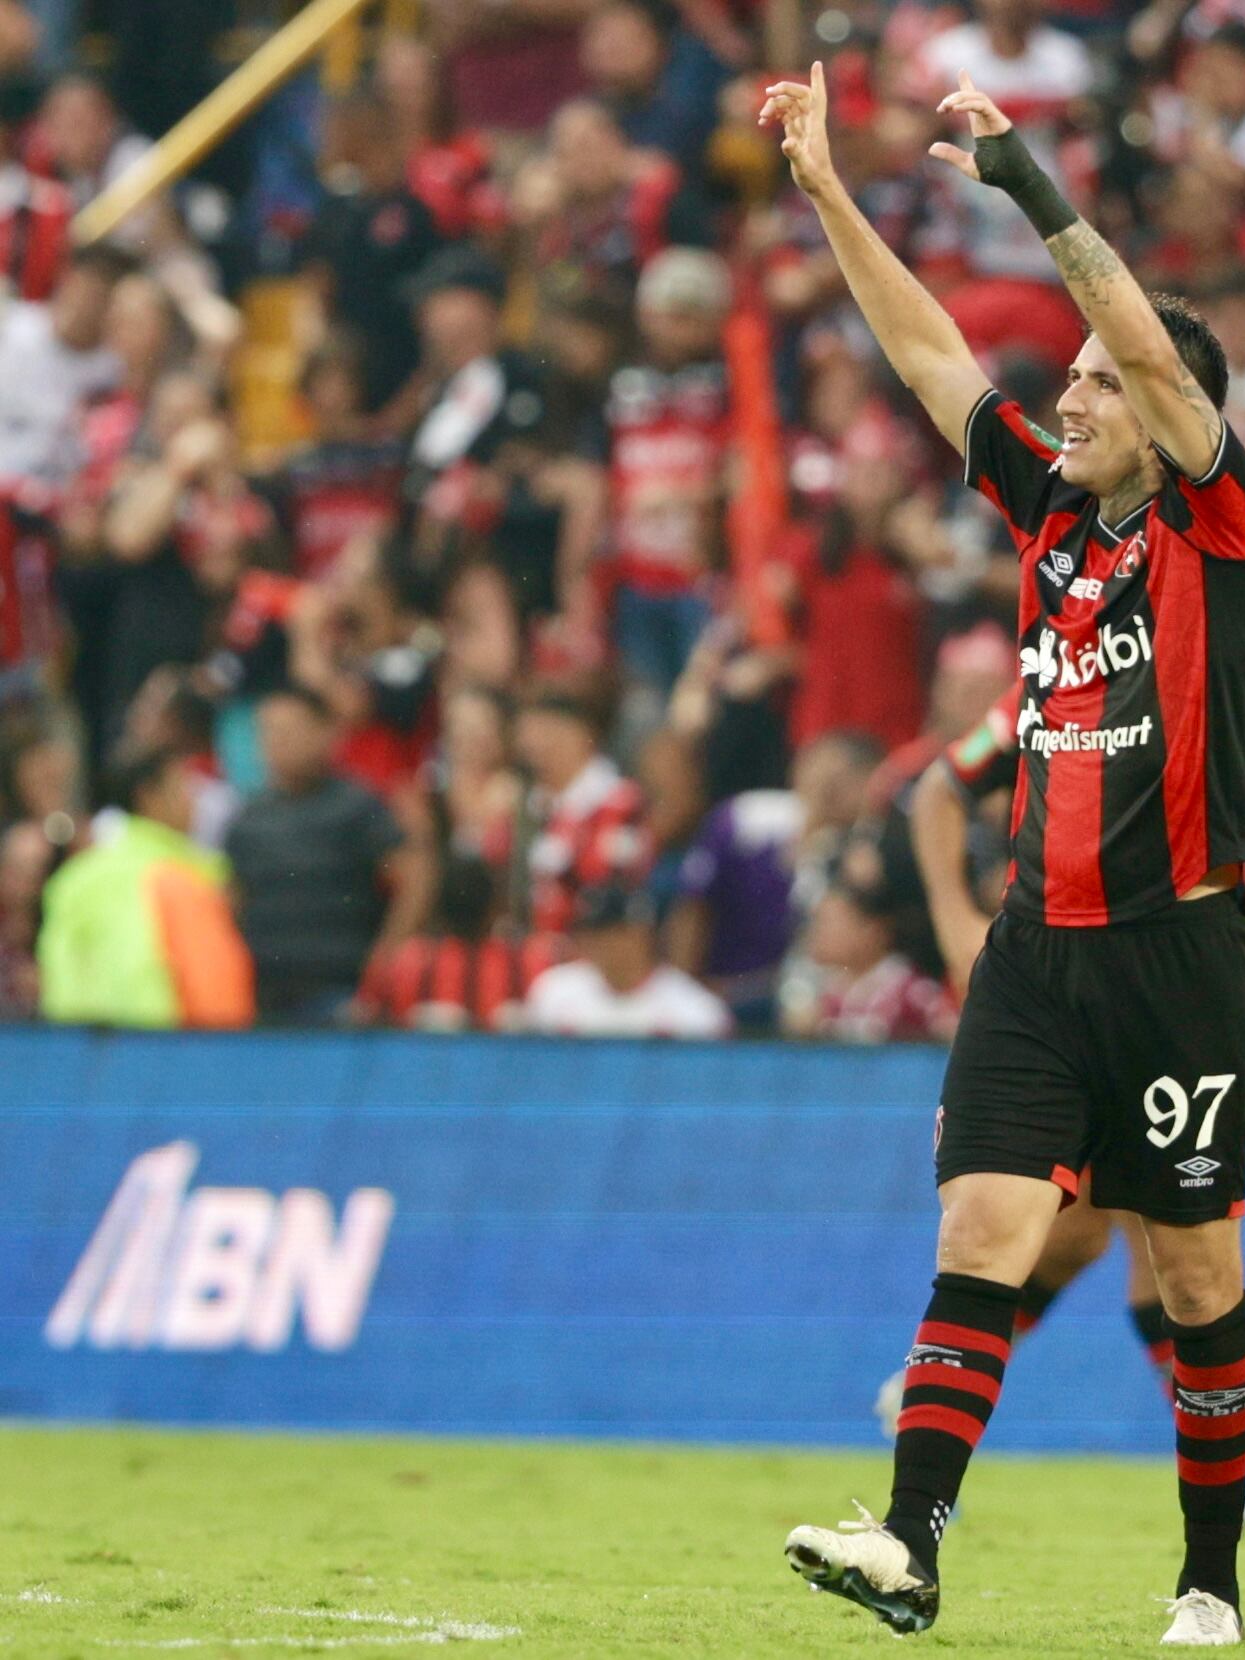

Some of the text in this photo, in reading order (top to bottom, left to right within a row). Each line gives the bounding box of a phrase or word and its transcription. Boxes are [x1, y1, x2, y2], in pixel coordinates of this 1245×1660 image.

[1039, 561, 1063, 587] umbro
[1060, 615, 1152, 688] kölbi
[1031, 715, 1152, 759] medismart
[1144, 1074, 1236, 1150] 97
[1180, 1175, 1214, 1188] umbro
